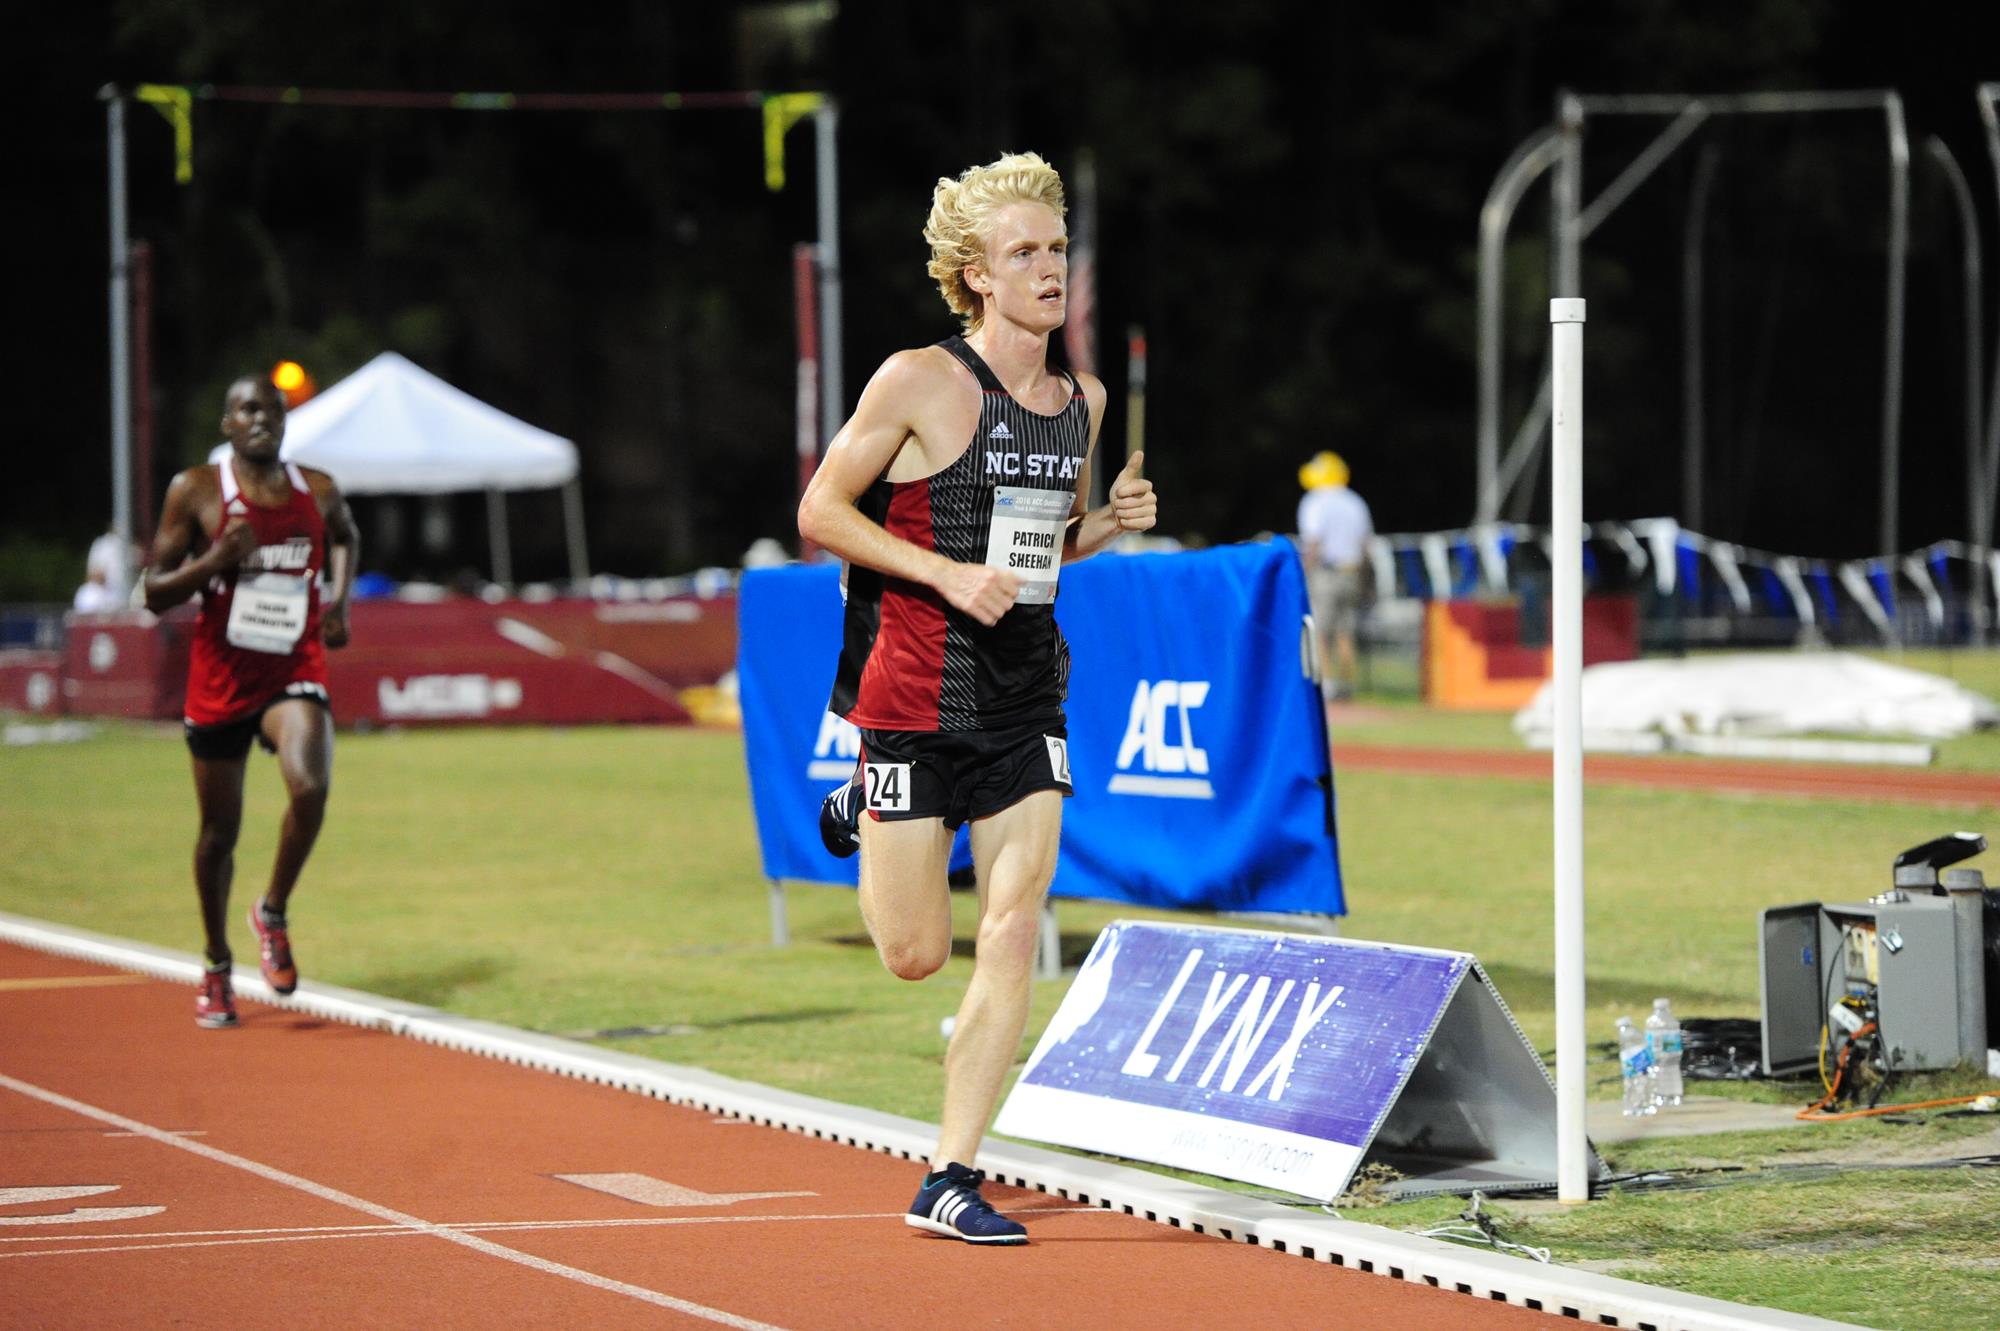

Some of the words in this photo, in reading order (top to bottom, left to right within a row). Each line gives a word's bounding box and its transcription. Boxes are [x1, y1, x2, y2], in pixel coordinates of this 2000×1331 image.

[985, 451, 1020, 475] NC
[1027, 453, 1085, 479] STAT
[1013, 531, 1057, 549] PATRICK
[1008, 552, 1053, 570] SHEEHAN
[1116, 679, 1211, 774] ACC
[867, 766, 902, 808] 24
[1121, 949, 1344, 1101] LYNX
